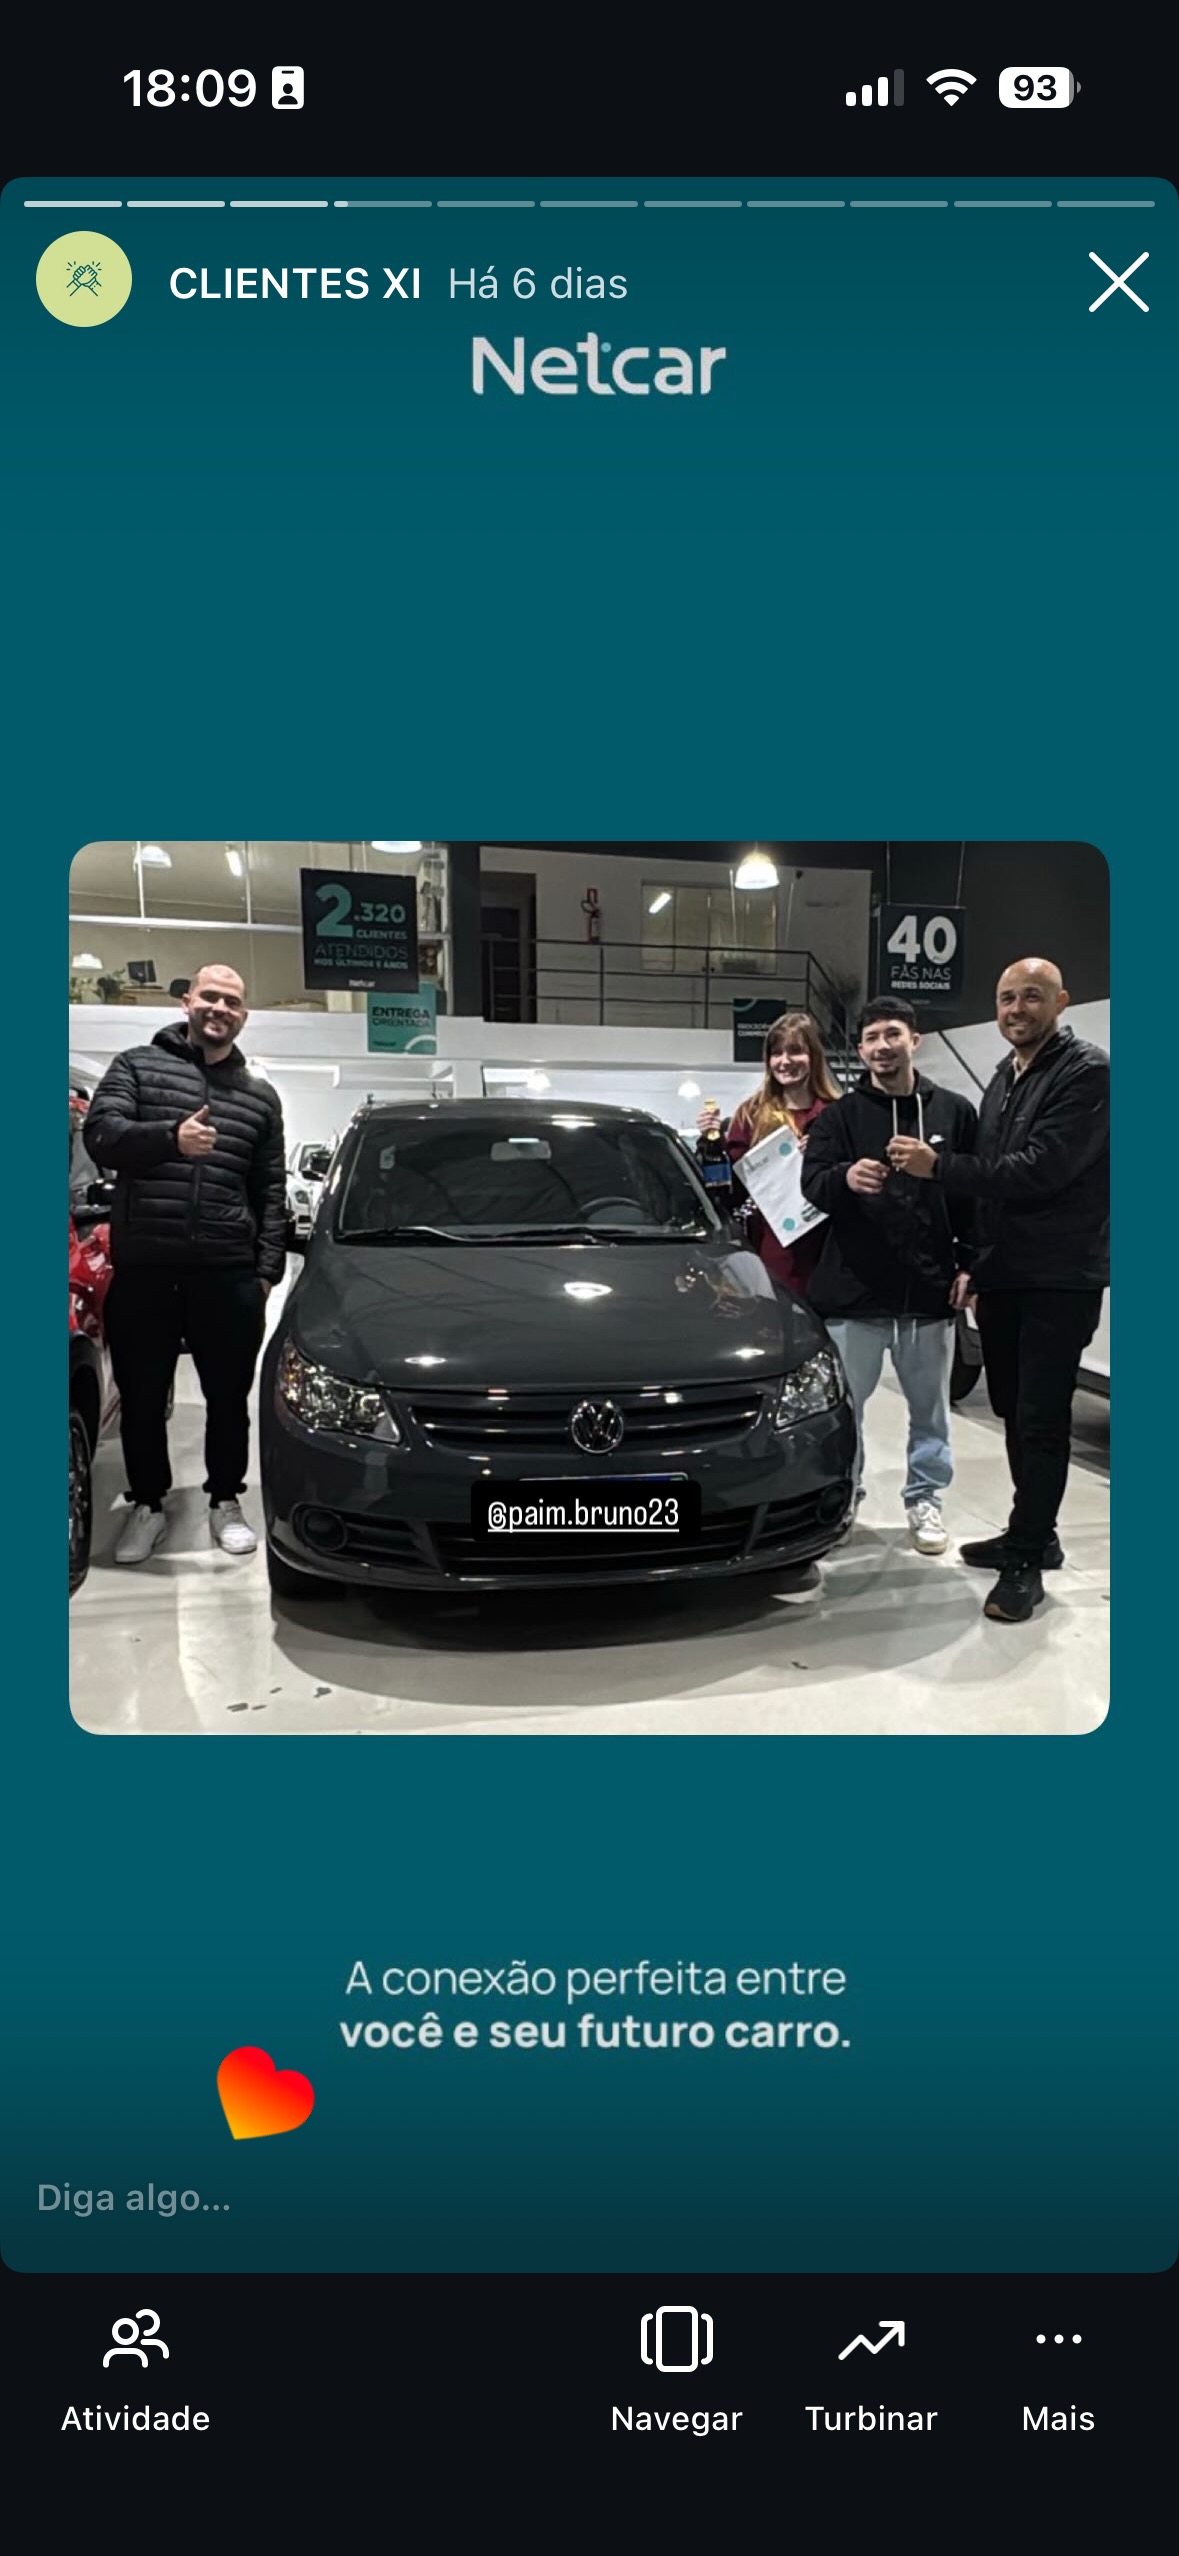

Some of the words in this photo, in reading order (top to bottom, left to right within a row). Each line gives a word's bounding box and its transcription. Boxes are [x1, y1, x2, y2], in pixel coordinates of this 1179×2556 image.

[356, 929, 408, 939] CLIENTES
[887, 914, 957, 966] 40
[315, 943, 409, 959] ATENDIDOS
[922, 967, 952, 981] NAS
[891, 980, 918, 990] REDES
[372, 1006, 431, 1019] ENTREGA
